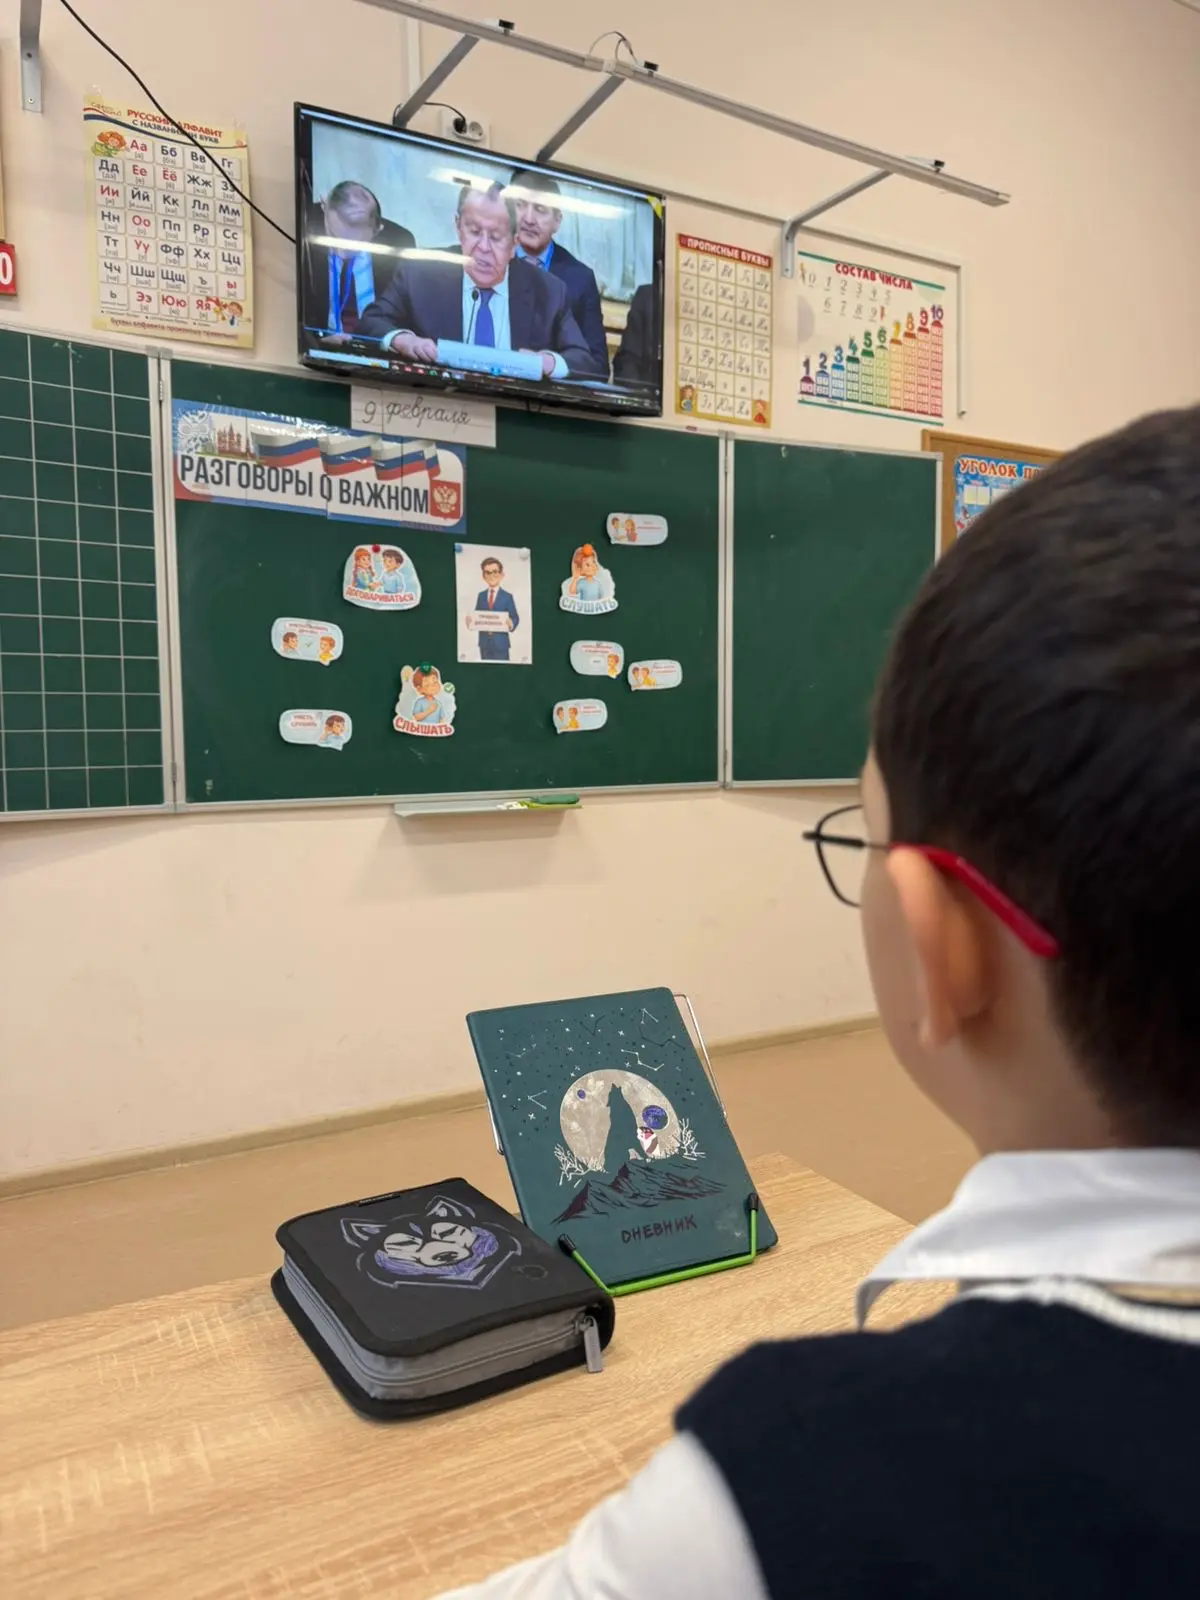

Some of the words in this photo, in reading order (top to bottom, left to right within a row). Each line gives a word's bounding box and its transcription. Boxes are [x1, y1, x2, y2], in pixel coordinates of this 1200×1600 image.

[130, 139, 148, 152] Аа
[161, 145, 177, 157] Бб
[191, 151, 206, 163] Вв
[221, 158, 233, 168] Гг
[99, 159, 120, 173] Дд
[132, 164, 147, 176] Ее
[162, 167, 177, 181] Ёё
[187, 174, 212, 188] Жж
[100, 185, 119, 198] Ии
[131, 186, 150, 201] Йй
[163, 195, 179, 207] Кк
[192, 199, 209, 211] Лл
[218, 204, 240, 217] Мм
[101, 210, 120, 223] Нн
[132, 215, 151, 228] Оо
[163, 219, 181, 231] Пп
[193, 223, 209, 238] Рр
[223, 229, 238, 240] Сс
[104, 235, 119, 247] Тт
[134, 239, 149, 254] Уу
[160, 244, 184, 259] Фф
[193, 248, 210, 260] Хх
[222, 252, 241, 266] Цц
[687, 238, 740, 259] ПРОПИСНЫЕ
[741, 251, 769, 267] БУКВЫ
[104, 261, 121, 274] Чч
[130, 265, 155, 278] Шш
[161, 269, 186, 283] Щщ
[199, 276, 207, 285] ъ
[226, 281, 237, 290] ы
[835, 263, 876, 281] СОСТАВ
[879, 273, 912, 290] ЧИСЛА
[110, 290, 117, 299] ь
[136, 291, 152, 303] Ээ
[161, 294, 186, 308] Юю
[195, 299, 211, 311] Яя
[803, 357, 810, 375] 1
[819, 353, 827, 369] 2
[835, 346, 843, 363] 3
[849, 338, 857, 355] 4
[863, 330, 872, 347] 5
[878, 328, 886, 344] 6
[906, 313, 914, 330] 8
[920, 308, 928, 325] 9
[931, 305, 943, 320] 10
[362, 401, 378, 424] 9
[386, 396, 472, 432] февраля
[959, 459, 1017, 478] УГОЛОК
[180, 454, 313, 497] РАЗГОВОРЫ
[339, 479, 429, 514] ВАЖНОМ
[345, 587, 414, 603] ДОГОВАРИВАТЬСЯ
[561, 597, 617, 613] СЛУШАТЬ
[395, 716, 453, 737] СЛЫШАТЬ
